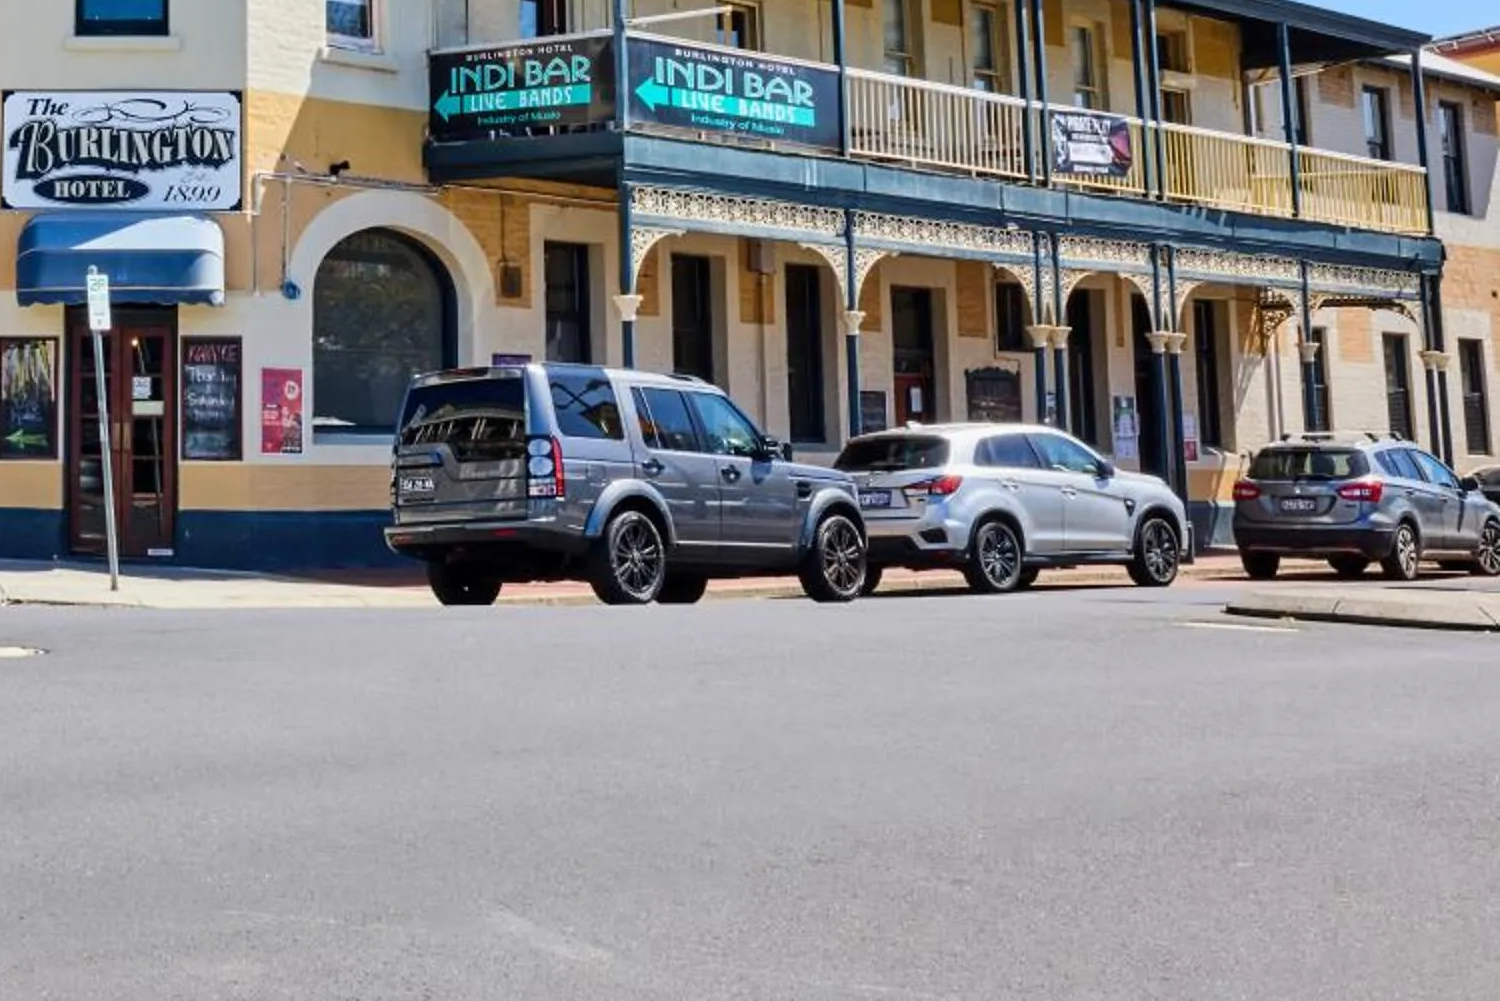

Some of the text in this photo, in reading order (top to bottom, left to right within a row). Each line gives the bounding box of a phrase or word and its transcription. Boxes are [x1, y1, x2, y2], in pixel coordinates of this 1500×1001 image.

[451, 54, 592, 94] INDI BAR
[674, 48, 797, 76] BURLINGTON HOTEL
[655, 56, 816, 108] INDI BAR
[27, 98, 70, 116] The
[471, 86, 573, 112] LIVE BANDS
[681, 91, 796, 123] LIVE BANDS
[8, 118, 235, 177] BURLINGTON
[54, 180, 132, 199] HOTEL
[163, 185, 222, 203] 1899
